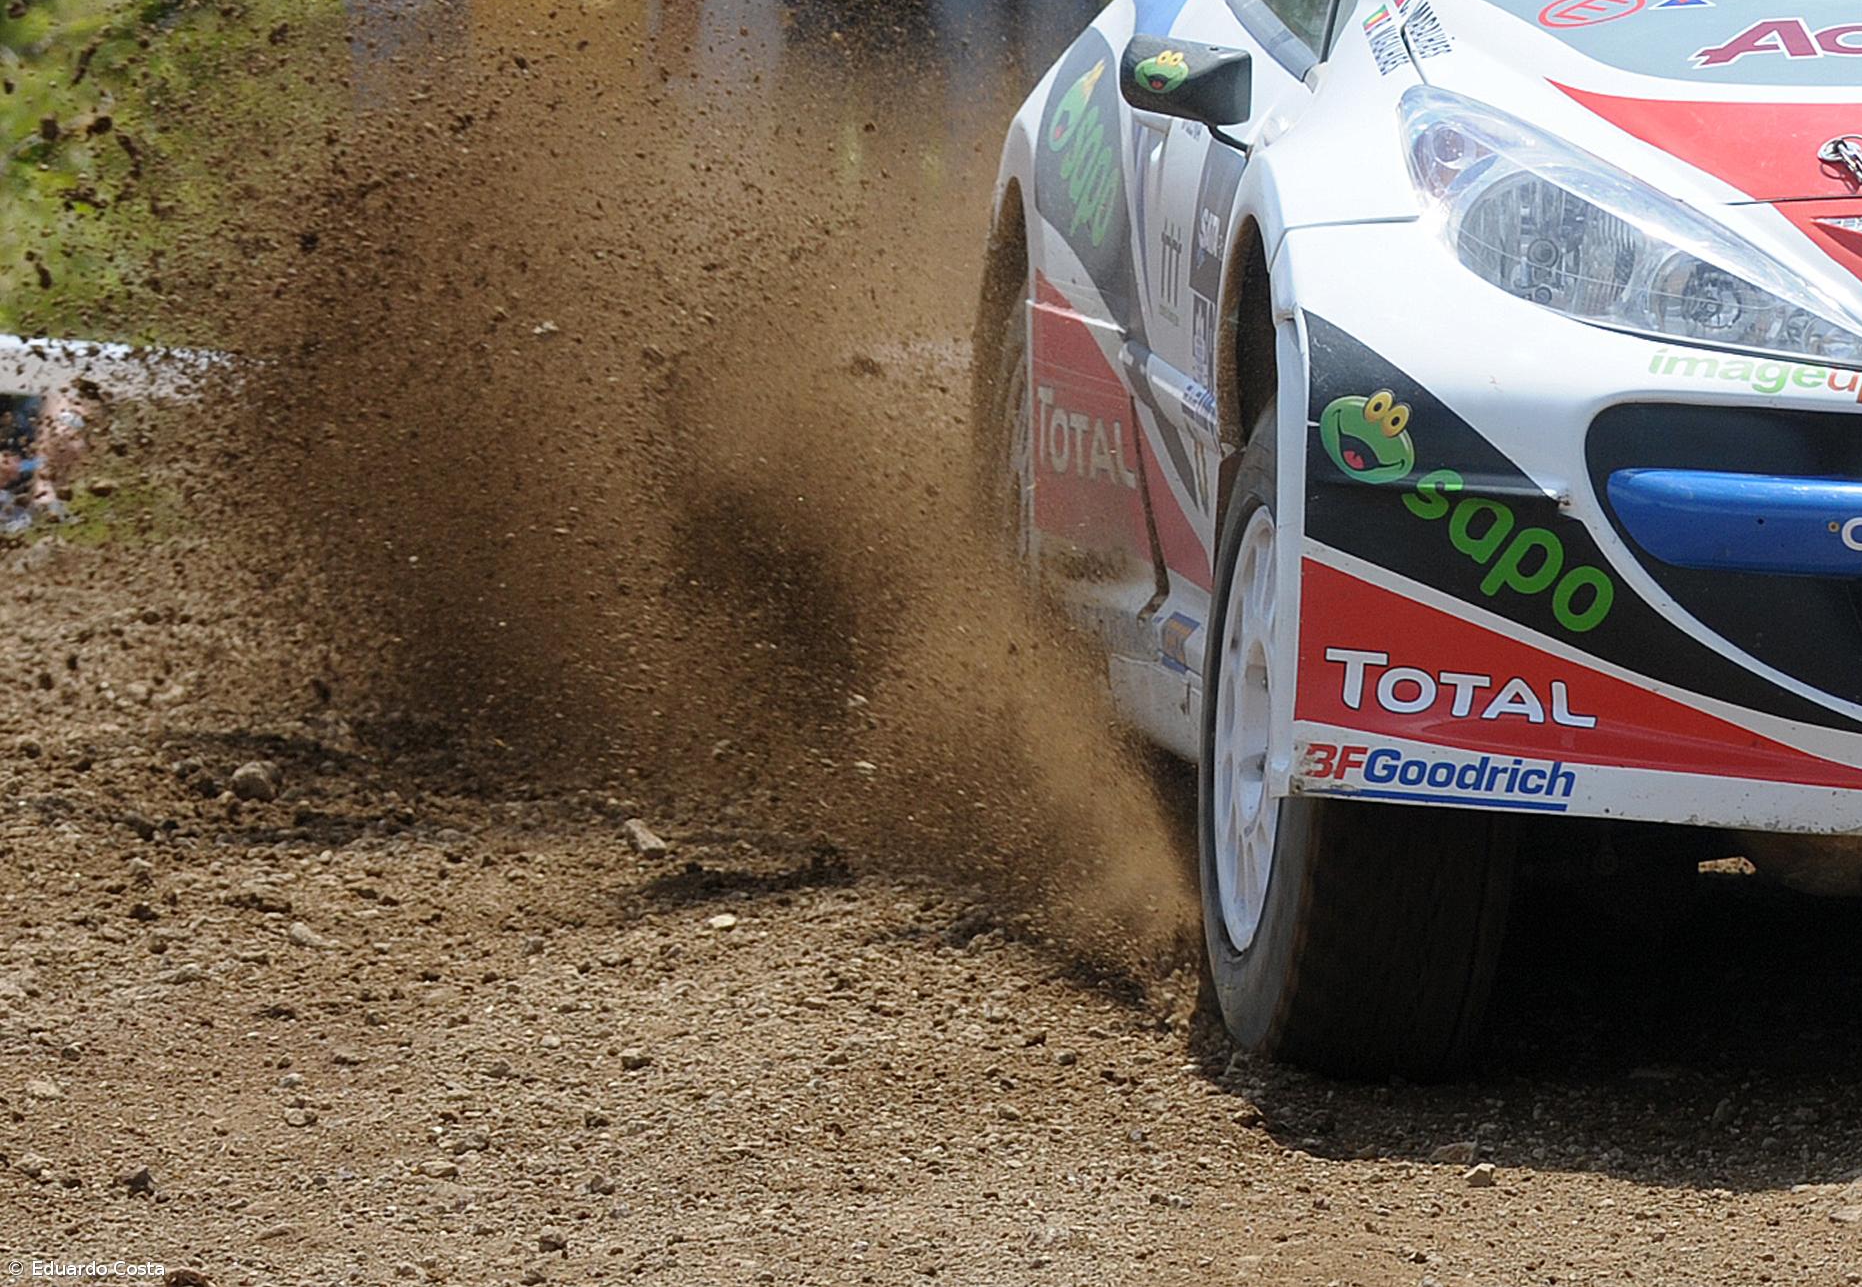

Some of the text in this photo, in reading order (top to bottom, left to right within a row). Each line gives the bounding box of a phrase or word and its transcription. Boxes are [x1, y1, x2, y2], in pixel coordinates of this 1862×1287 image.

[1060, 105, 1120, 248] sapo
[1037, 385, 1137, 489] TOTAL
[1400, 468, 1615, 632] sapo
[1325, 646, 1598, 728] TOTAL
[1305, 742, 1576, 798] BFGoodrich
